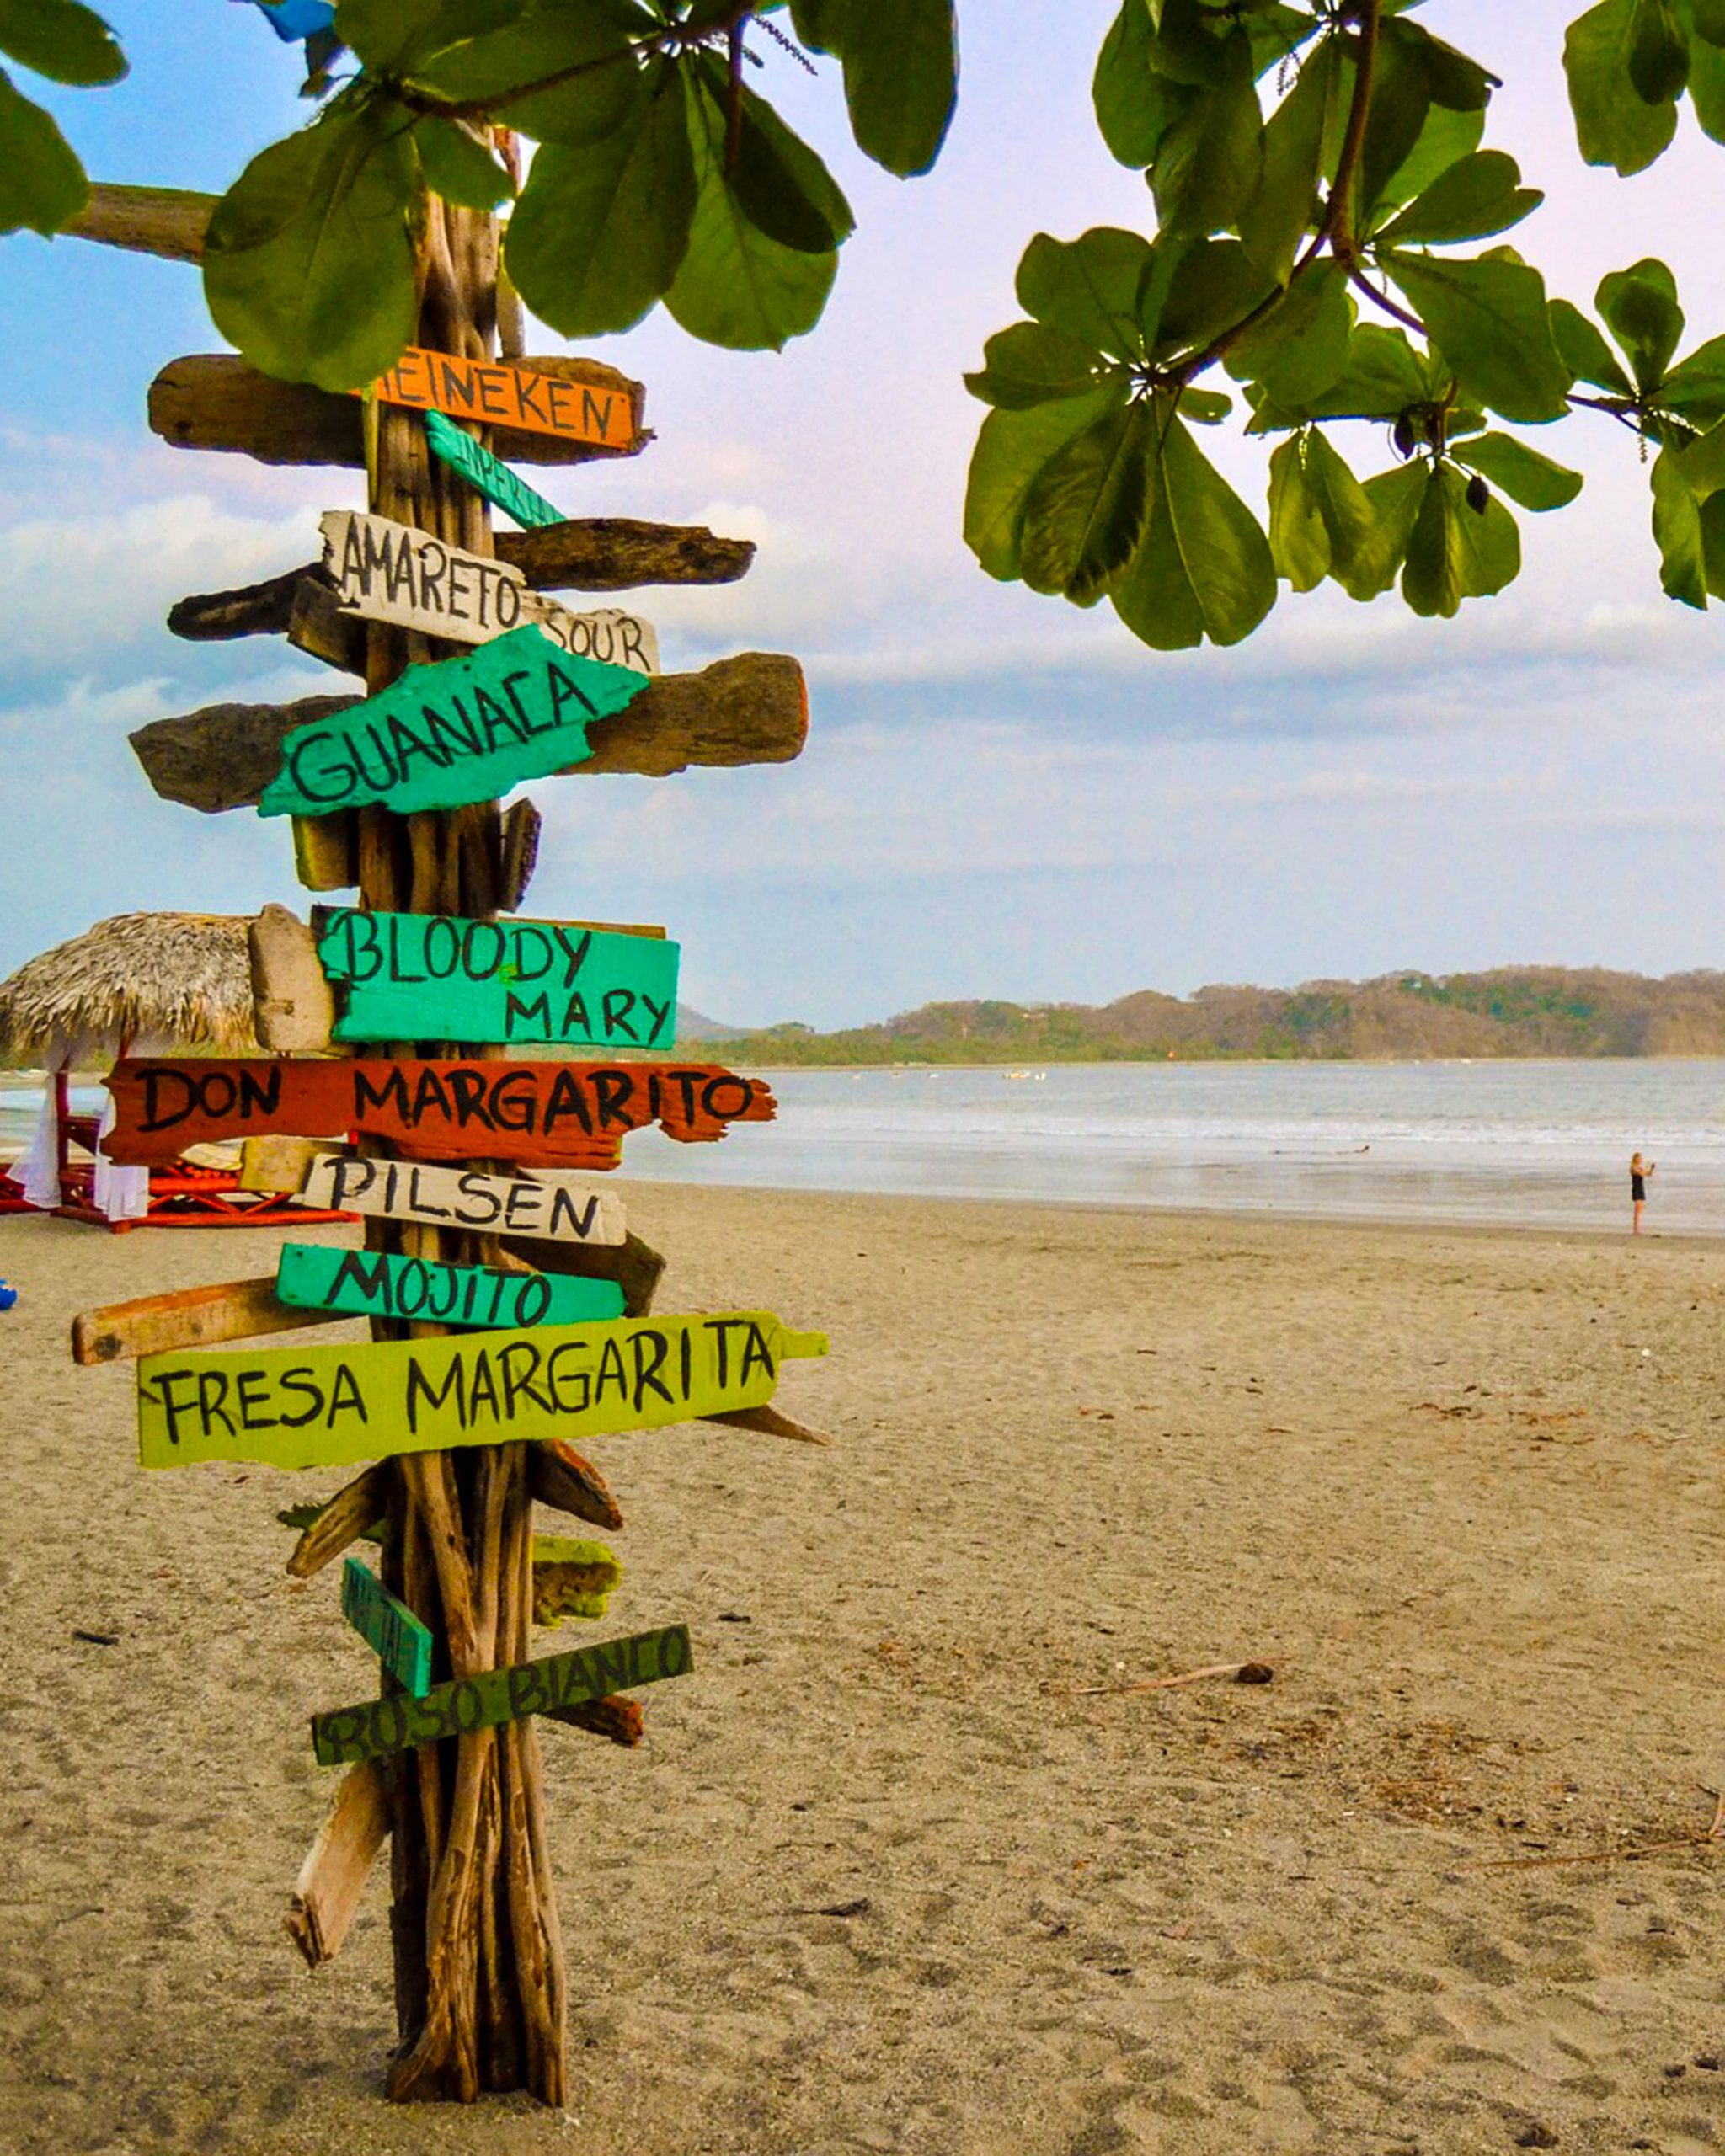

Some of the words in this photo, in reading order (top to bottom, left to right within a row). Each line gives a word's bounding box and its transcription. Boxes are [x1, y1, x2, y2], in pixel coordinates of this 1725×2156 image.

[383, 351, 613, 440] EINEKEN
[341, 513, 521, 629] AMARETO
[544, 607, 652, 673] SOUR
[290, 661, 599, 803] GUANACA
[332, 908, 592, 990] BLOODY
[505, 988, 672, 1045] MARY
[136, 1066, 282, 1132] DON
[354, 1067, 755, 1137] MARGARITO
[324, 1157, 600, 1240] PILSEN
[327, 1250, 553, 1327] MOJITO
[151, 1364, 369, 1444] FRESA
[407, 1319, 776, 1435] MARGARITA
[507, 1625, 692, 1721] BIANCO
